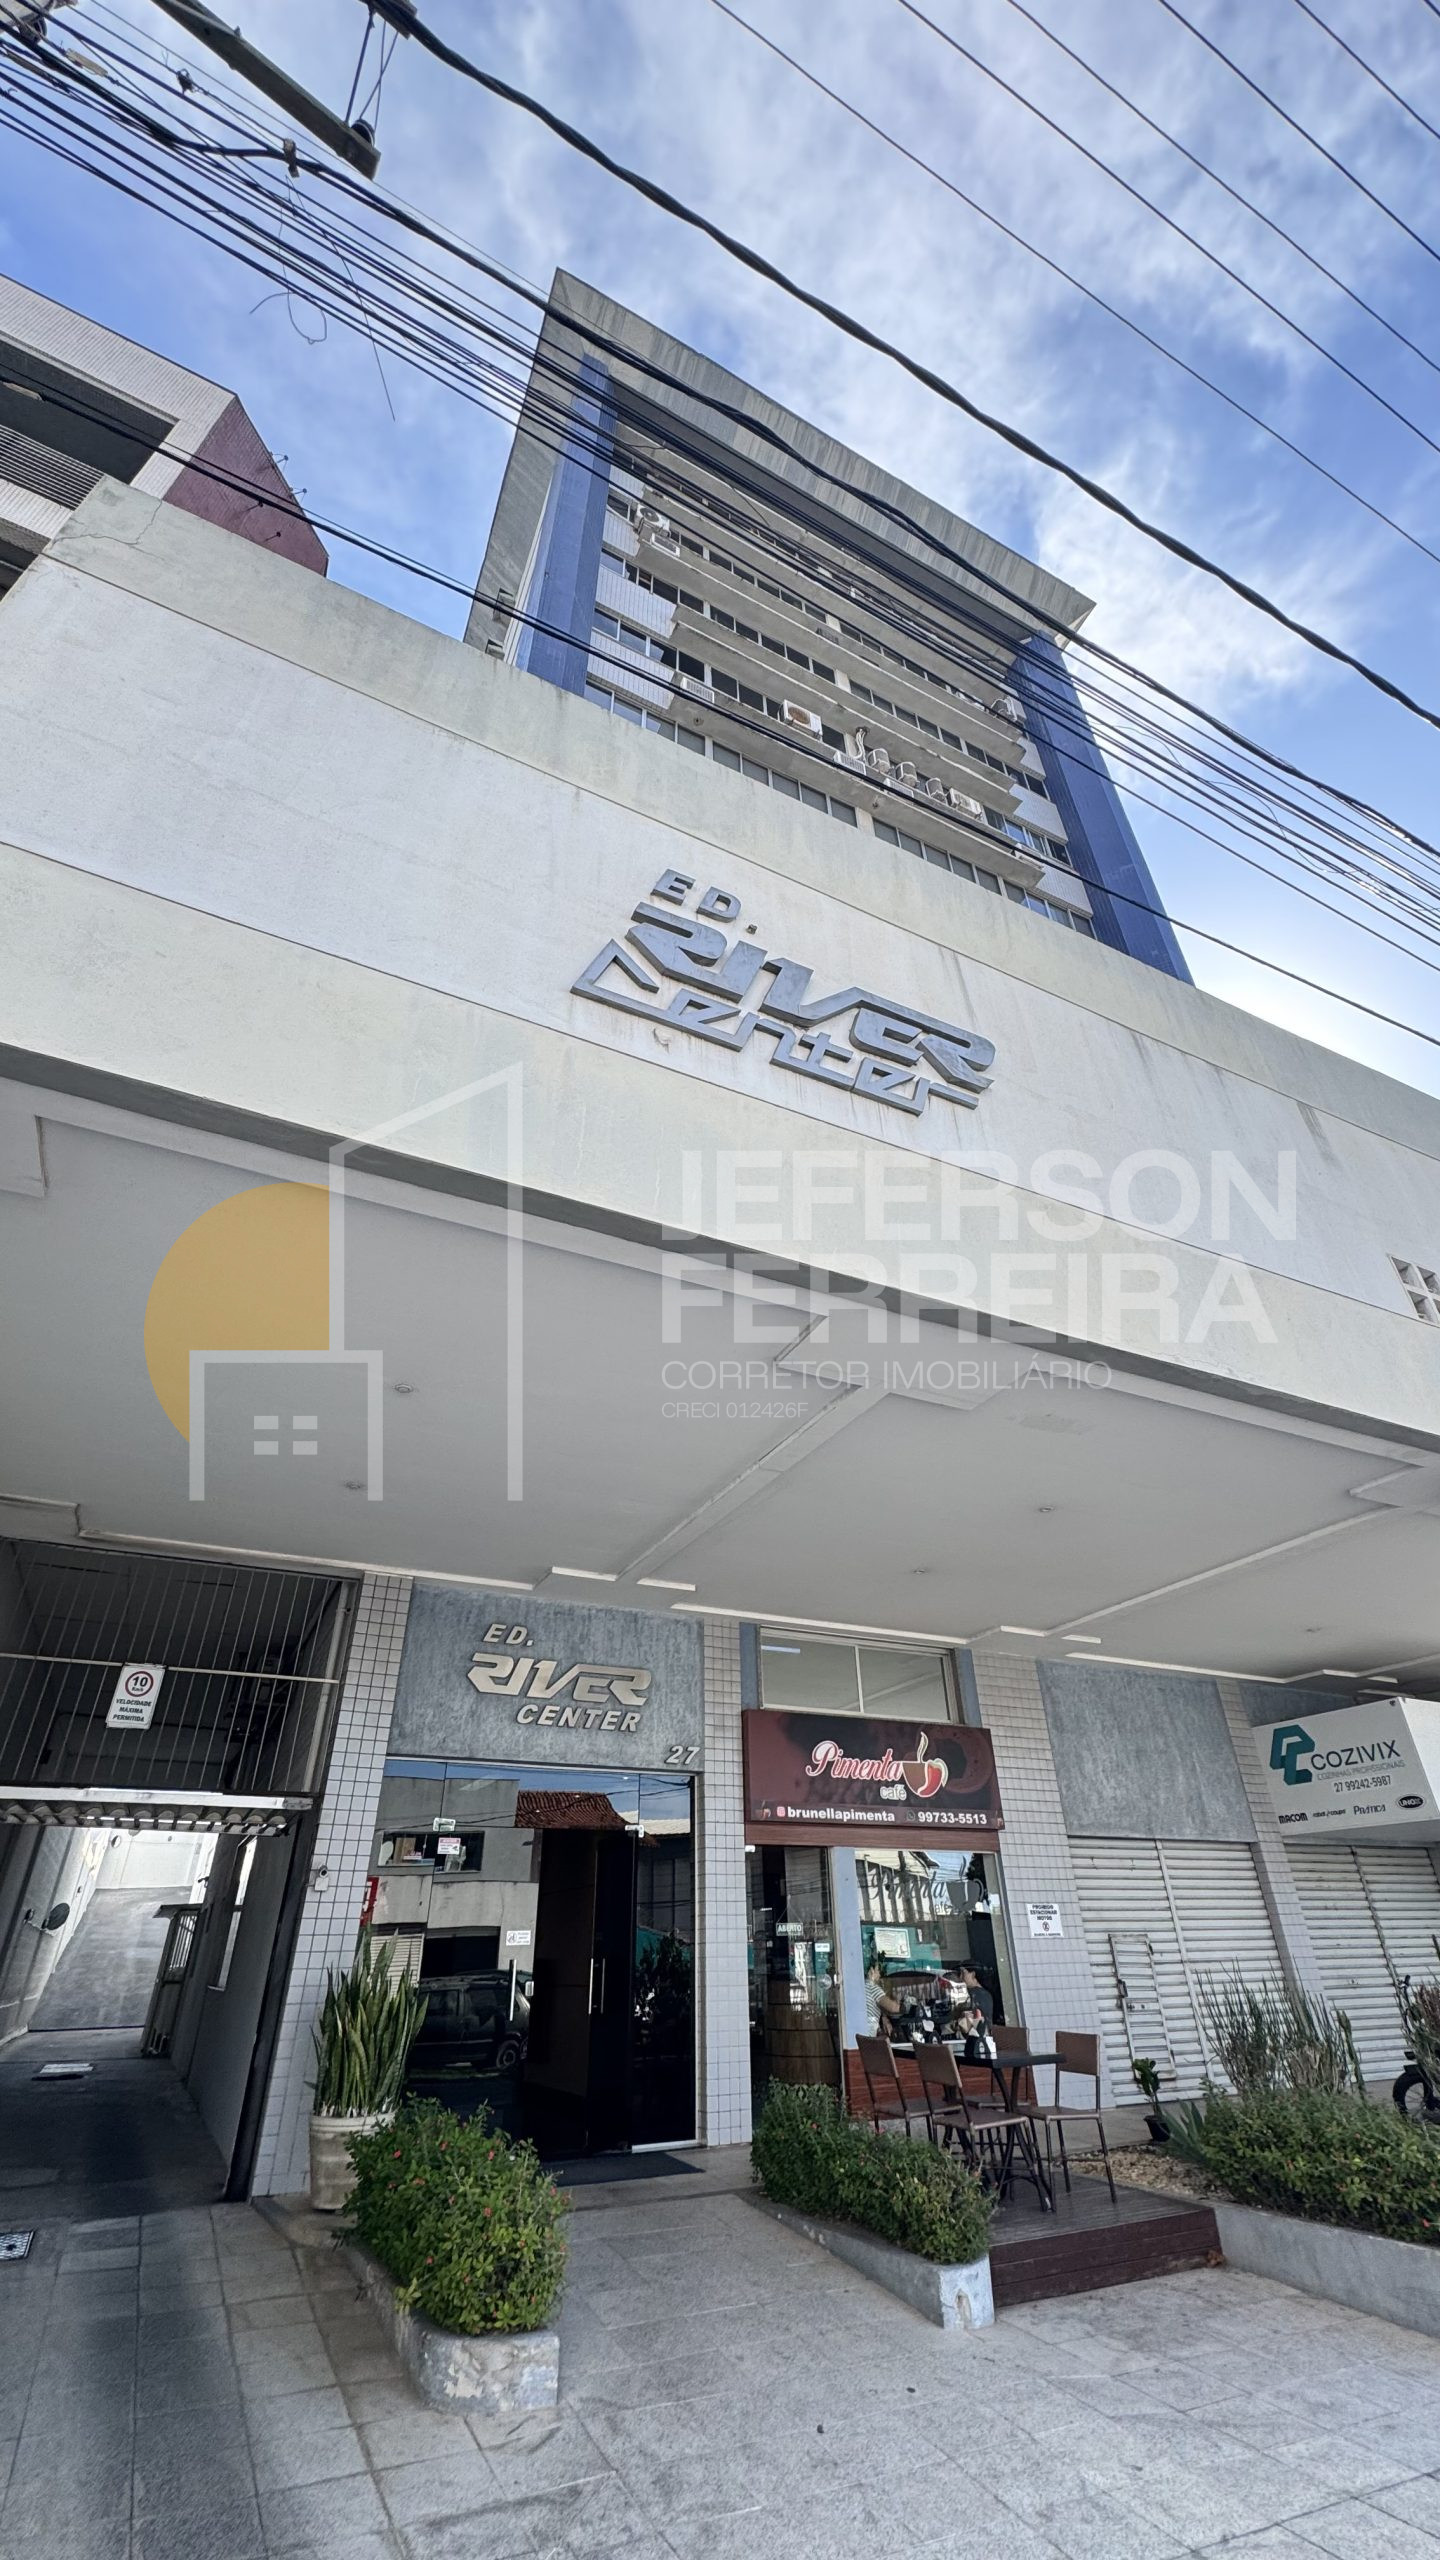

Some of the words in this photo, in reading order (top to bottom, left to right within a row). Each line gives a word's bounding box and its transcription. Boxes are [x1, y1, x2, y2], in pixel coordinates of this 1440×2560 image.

[650, 868, 758, 935] ED.
[625, 901, 996, 1094] RIVER
[483, 1623, 535, 1647] ED.
[132, 1675, 149, 1687] 10
[467, 1652, 651, 1706] RIVER
[116, 1699, 152, 1707] VELOCIDADE
[112, 1714, 145, 1722] PERMITIDA
[516, 1704, 642, 1733] CENTER
[665, 1745, 700, 1765] 27
[805, 1740, 903, 1781] Pimenta
[1310, 1739, 1401, 1771] COZIVIX
[880, 1784, 907, 1800] café
[1333, 1782, 1344, 1793] 27
[1346, 1775, 1391, 1791] 99242-5987
[787, 1806, 895, 1822] brunellapimenta
[917, 1811, 987, 1824] 99733-5513
[1278, 1812, 1308, 1824] MACOM
[777, 1924, 802, 1932] ABERTO
